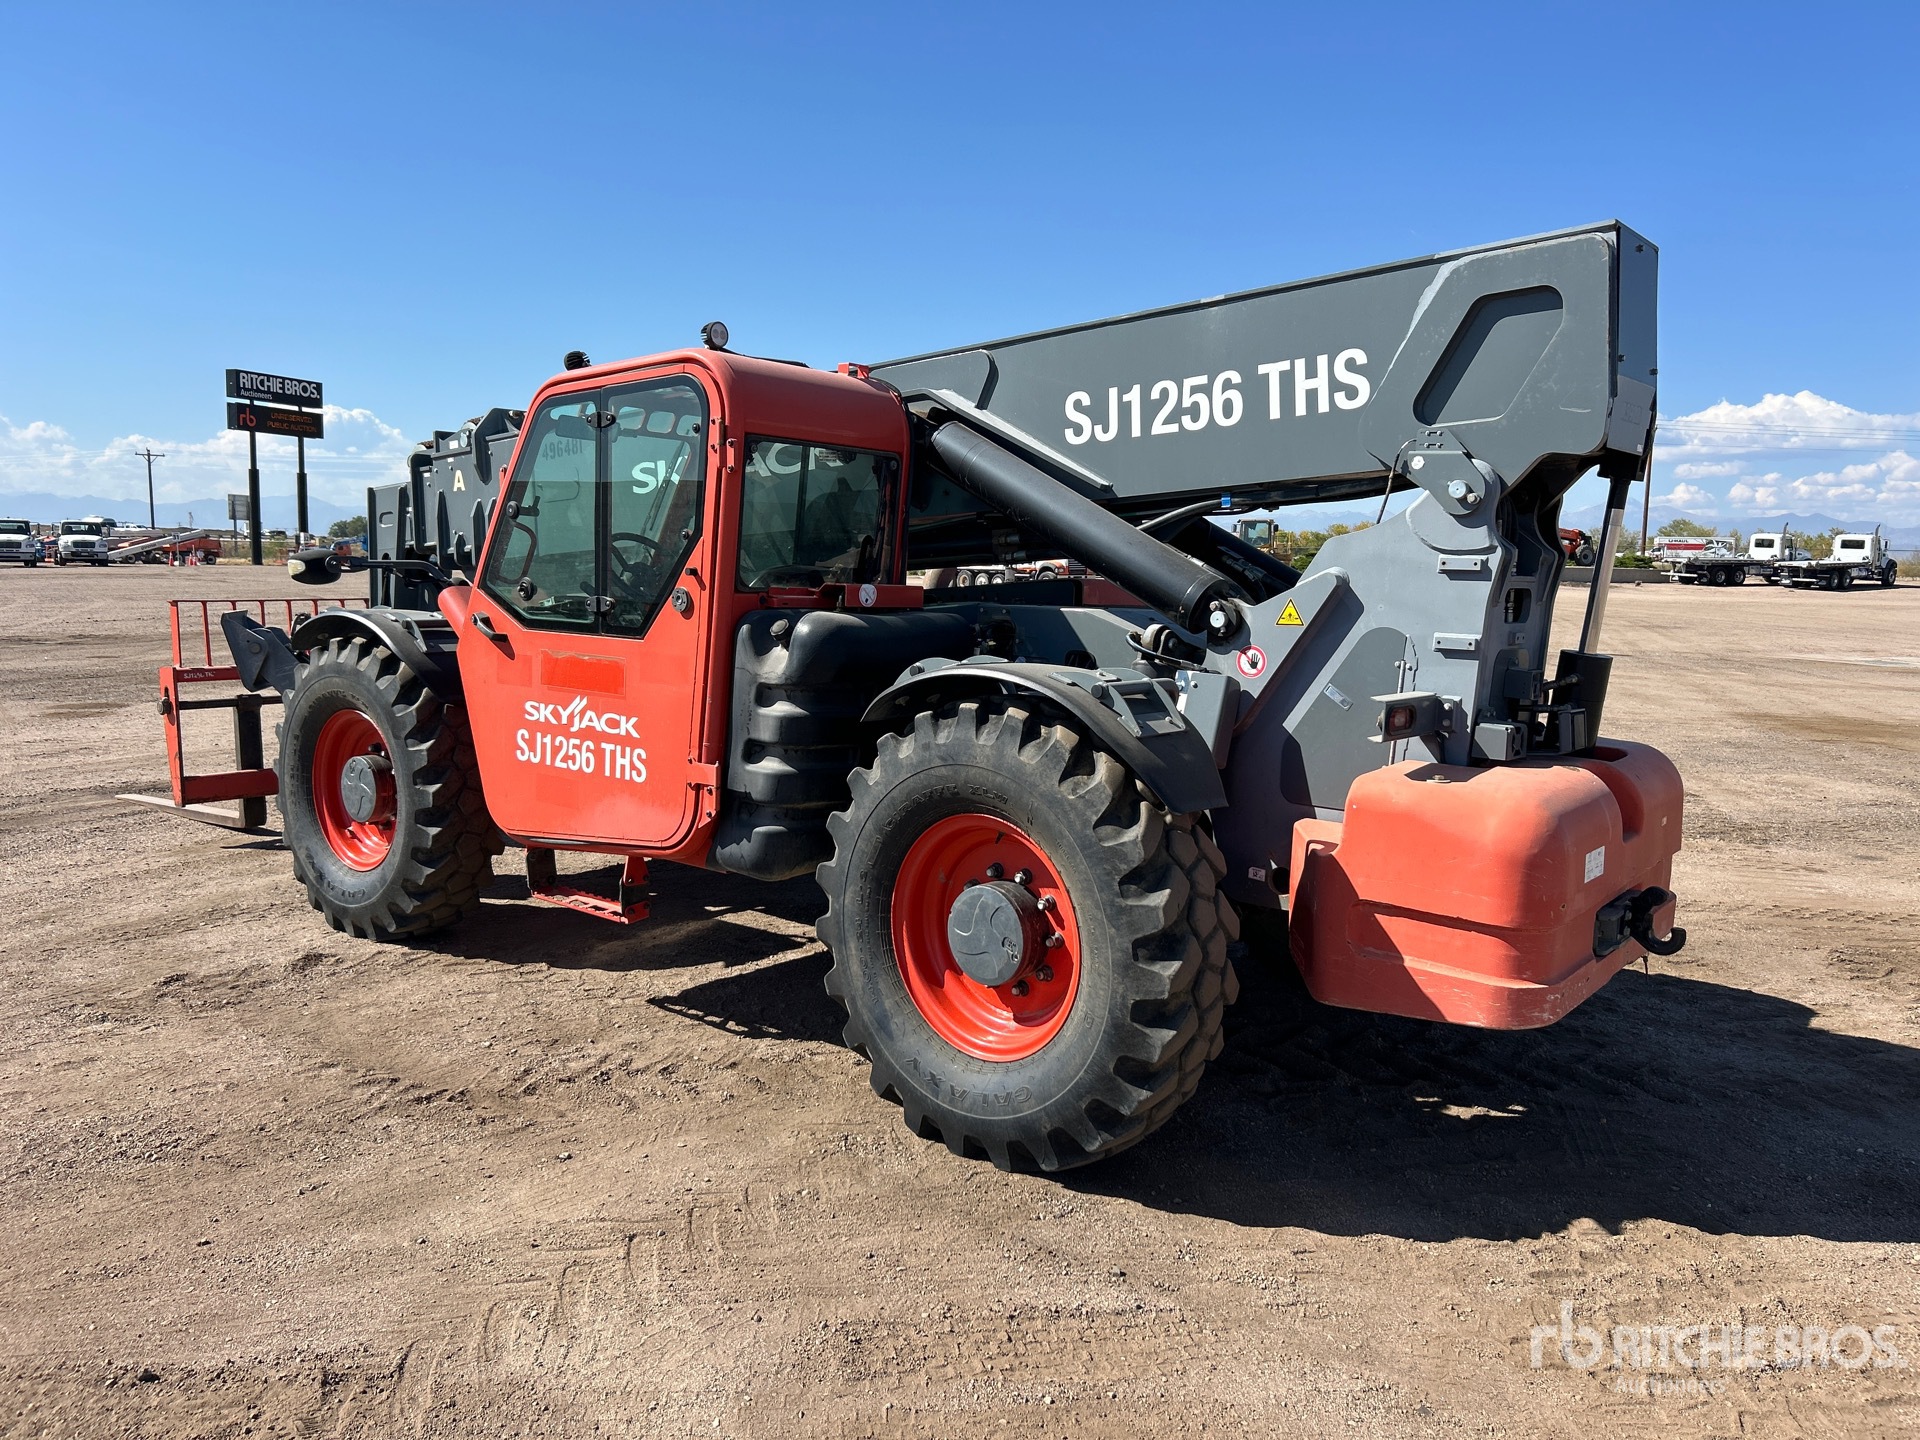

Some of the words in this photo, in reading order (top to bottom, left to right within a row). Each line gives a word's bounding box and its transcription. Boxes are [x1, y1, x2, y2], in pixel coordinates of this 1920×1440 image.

[239, 372, 283, 393] RITCHIE
[284, 379, 320, 399] BROS.
[240, 388, 273, 400] Auctioneers
[1064, 369, 1244, 445] SJ1256
[1257, 347, 1371, 420] THS
[239, 407, 257, 427] rb
[266, 420, 289, 430] PUBLIC
[290, 424, 317, 433] AUCTION
[270, 412, 312, 423] UNRESERVED
[453, 469, 466, 492] A
[524, 694, 641, 739] SKYJACK
[515, 728, 595, 774] SJ1256
[600, 742, 647, 784] THS
[903, 1057, 1033, 1107] GALAXY
